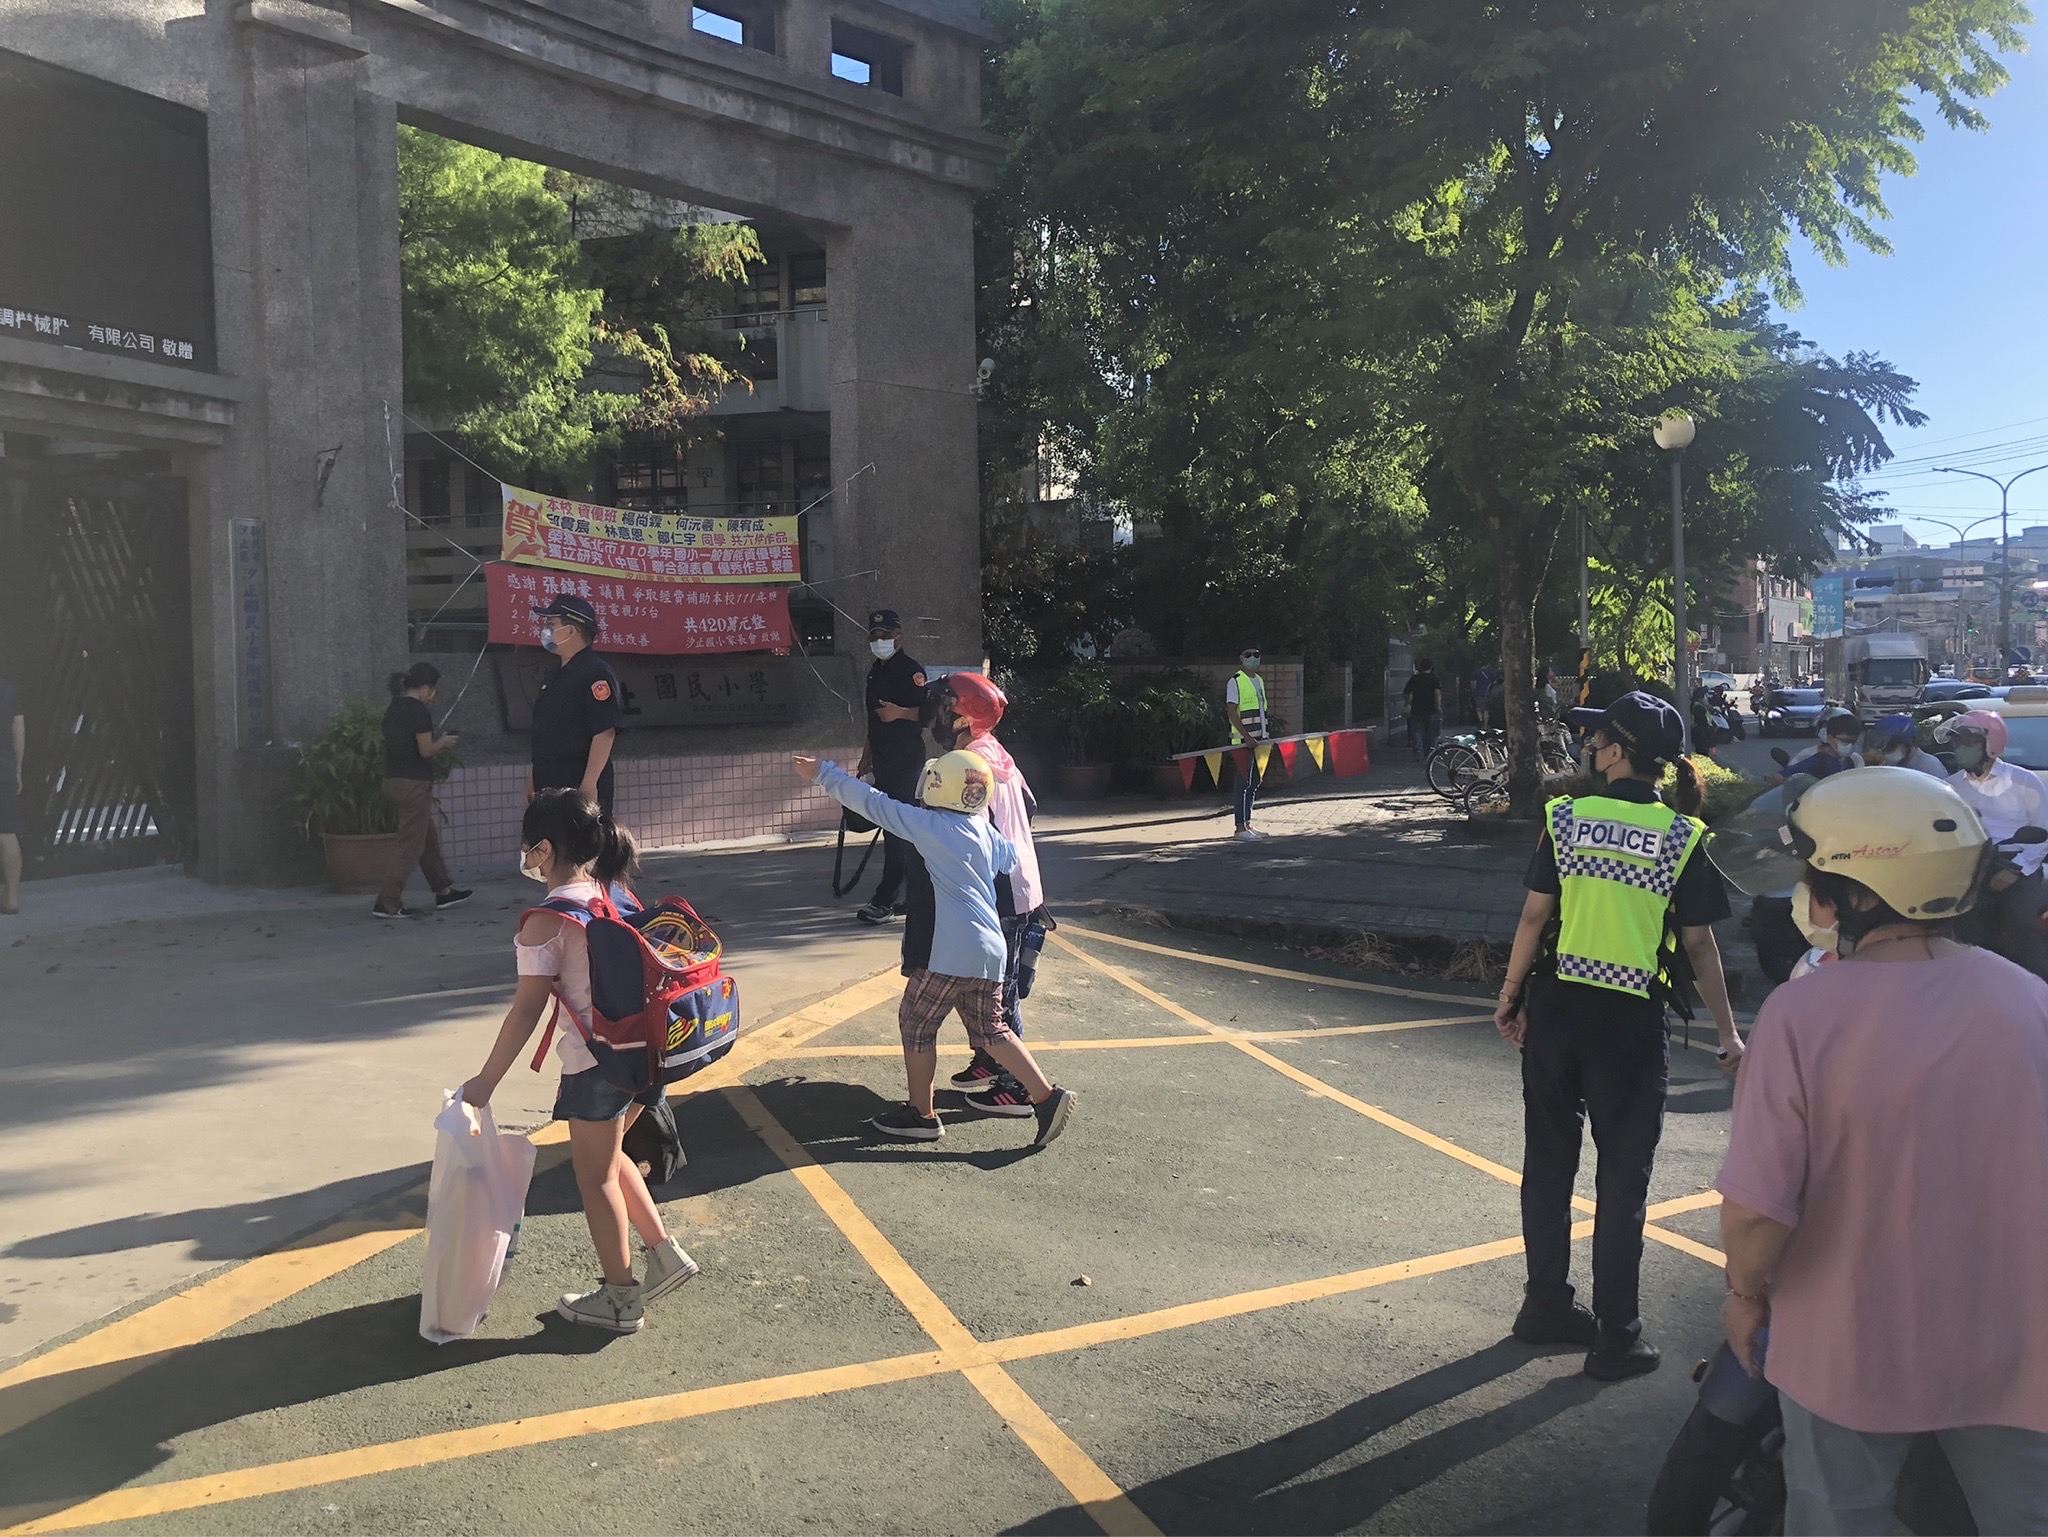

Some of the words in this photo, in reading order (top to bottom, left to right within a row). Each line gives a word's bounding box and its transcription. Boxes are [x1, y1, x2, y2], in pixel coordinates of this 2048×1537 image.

[88, 325, 155, 353] 有限公司
[162, 338, 193, 360] 敬贈
[506, 499, 543, 543] 賀
[546, 498, 574, 516] 本校
[578, 504, 618, 523] 資優班
[701, 533, 727, 547] 同學
[730, 532, 788, 547] 共六件作品
[718, 562, 768, 575] 優秀作品
[507, 573, 537, 592] 感謝
[542, 576, 594, 599] 張錦豪
[599, 583, 626, 601] 議員
[684, 614, 766, 634] 共420萬元整
[1577, 823, 1657, 854] POLICE
